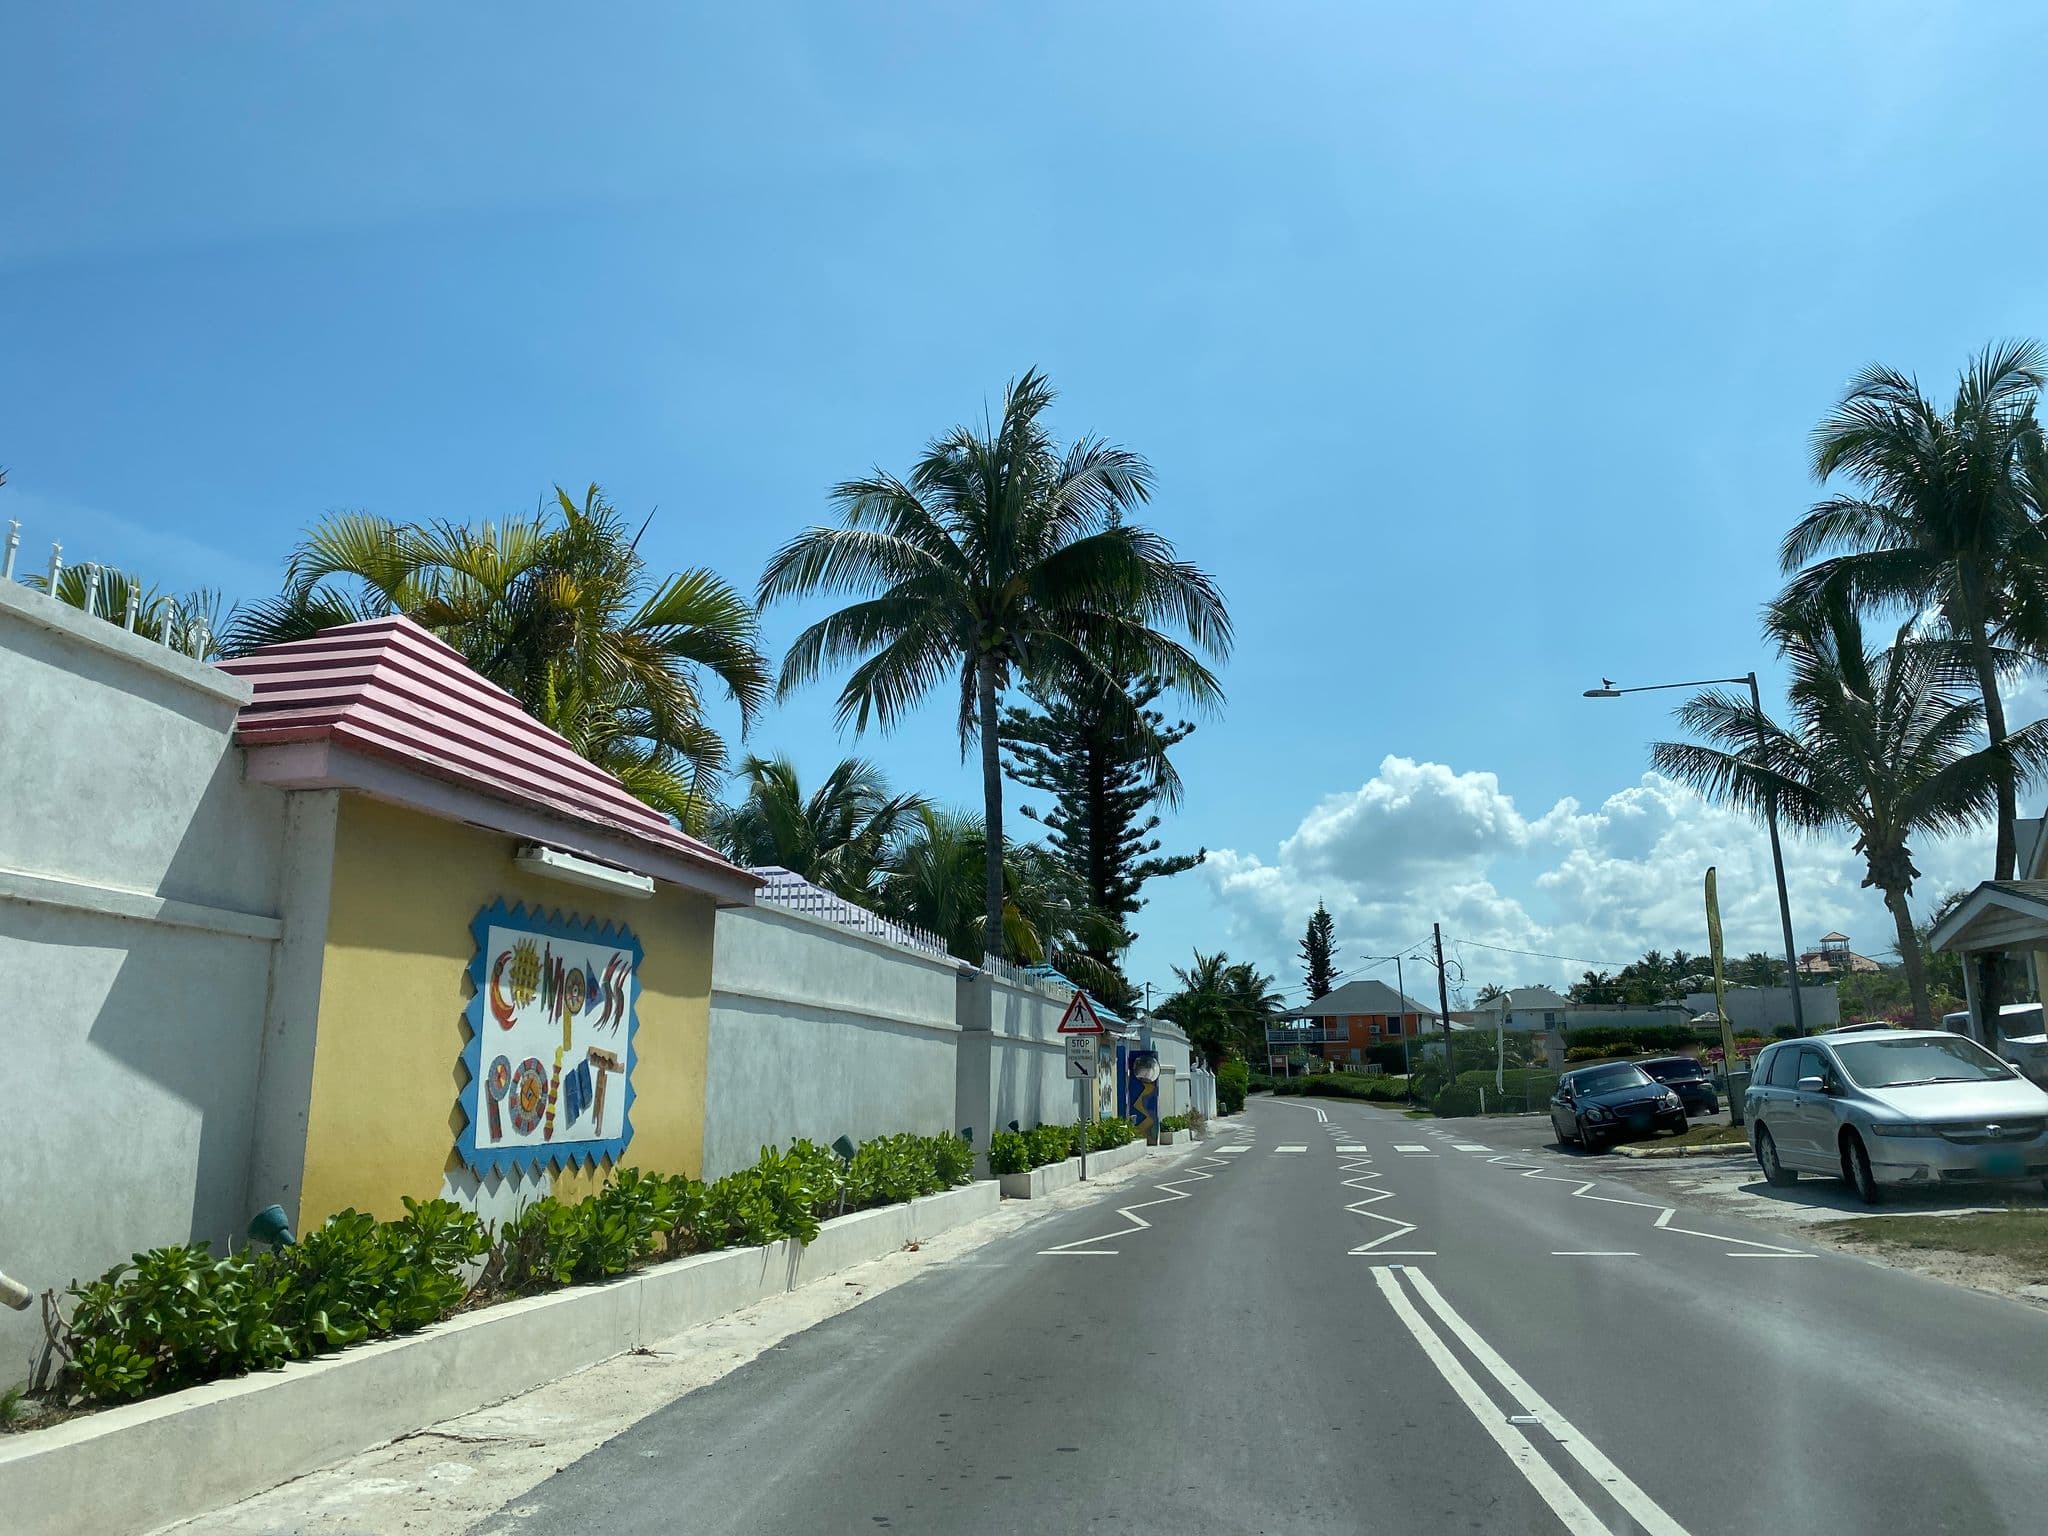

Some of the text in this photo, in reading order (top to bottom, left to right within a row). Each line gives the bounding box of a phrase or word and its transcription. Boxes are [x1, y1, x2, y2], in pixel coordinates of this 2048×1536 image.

[490, 936, 633, 1050] COMPASS
[1071, 1039, 1090, 1048] STOP
[485, 1045, 625, 1143] POINT
